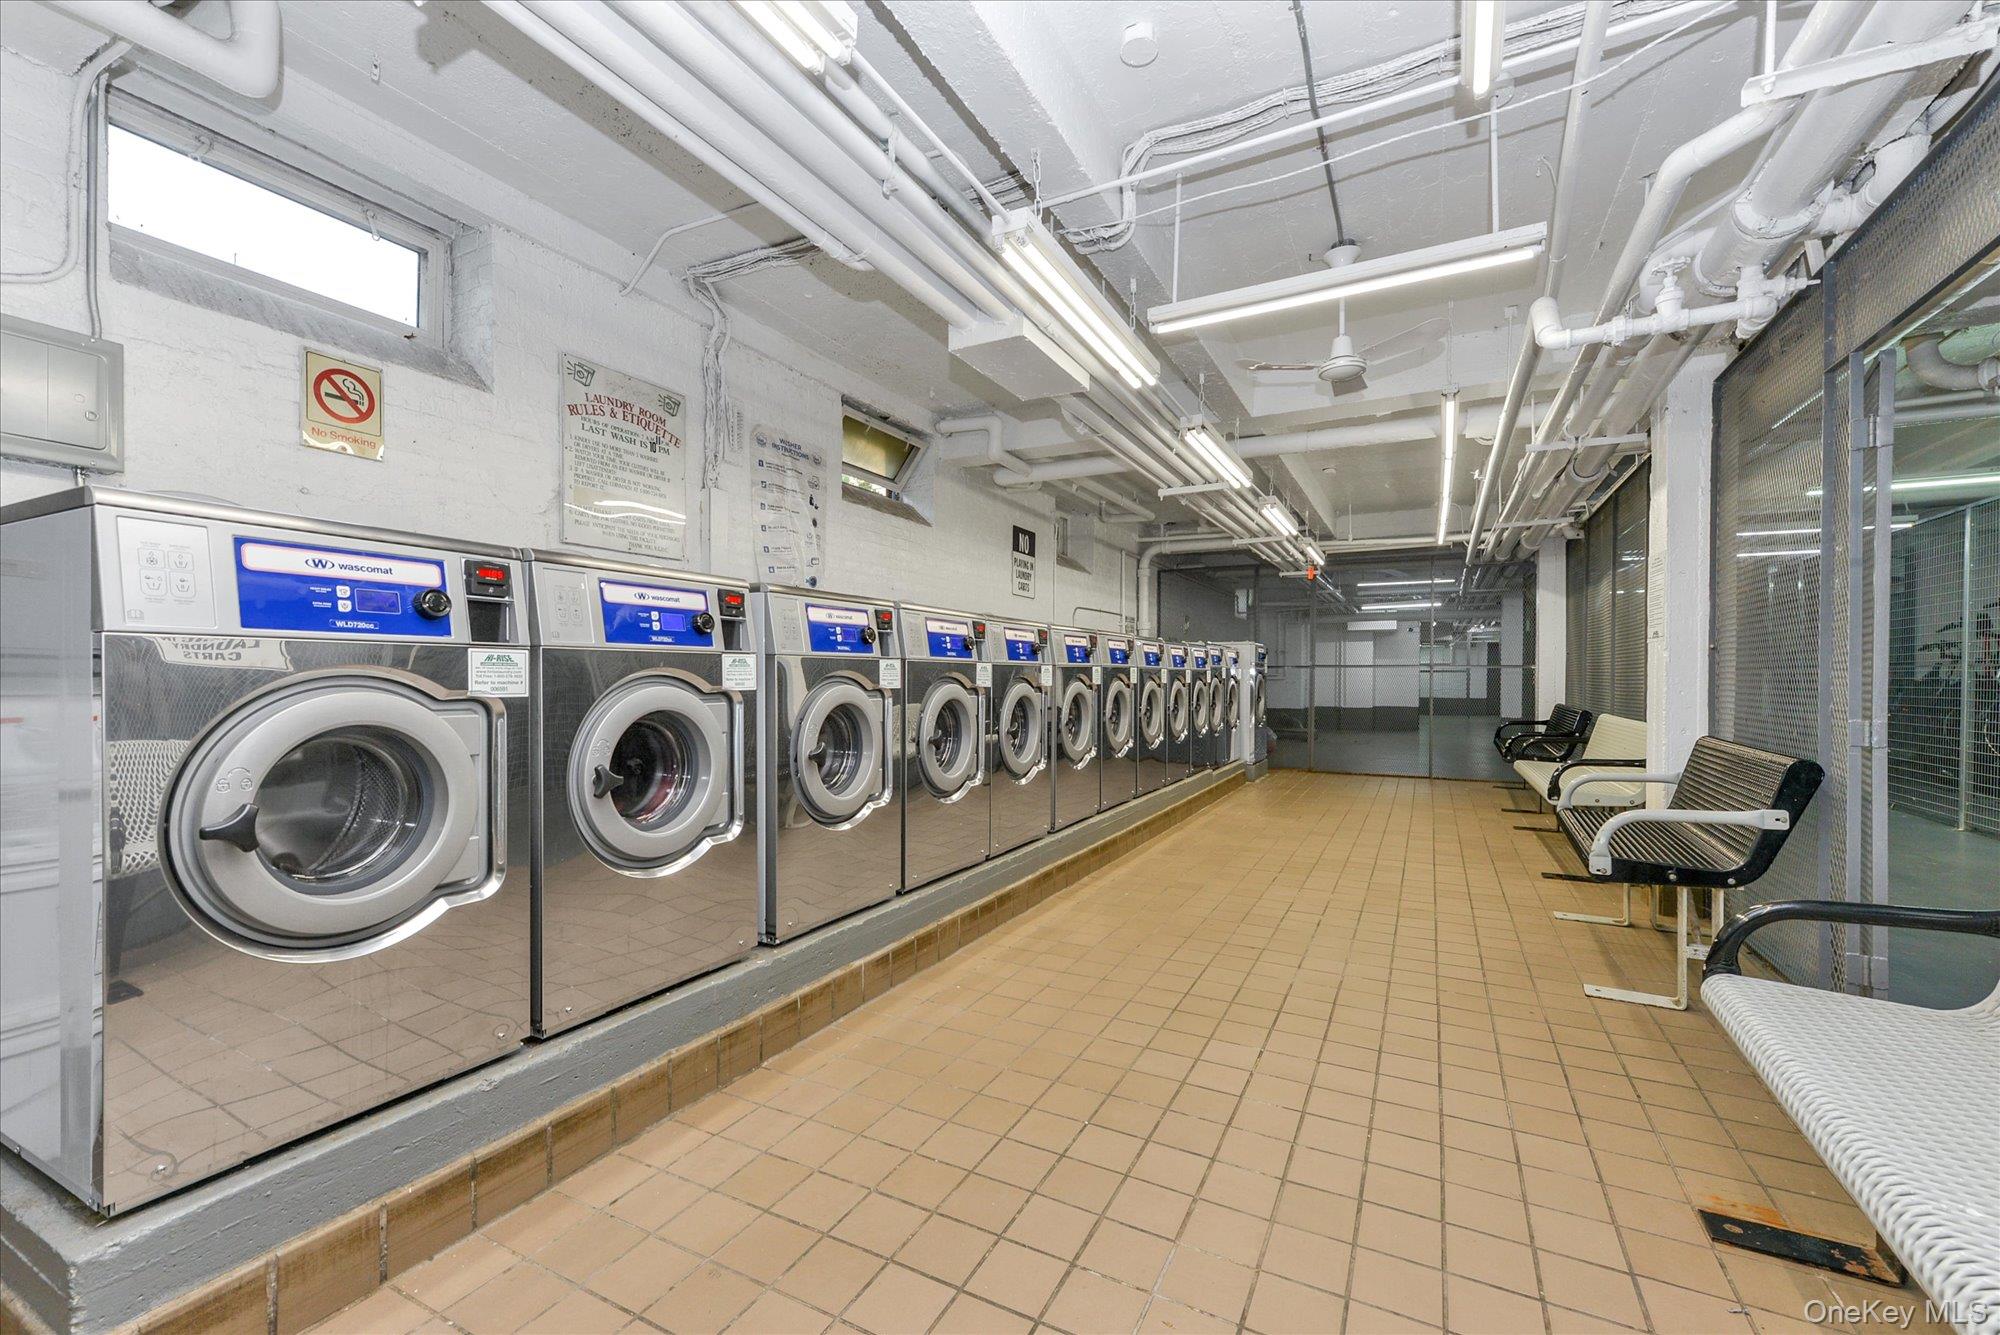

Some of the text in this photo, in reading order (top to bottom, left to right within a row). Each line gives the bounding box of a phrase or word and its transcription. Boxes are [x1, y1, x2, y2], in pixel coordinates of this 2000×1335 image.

[585, 392, 666, 427] LAUNDRY ROOM
[567, 404, 682, 448] RULES & ETIQUETTE
[580, 416, 600, 426] HOURS
[312, 427, 376, 449] No Smoking
[581, 423, 608, 436] LAST
[610, 430, 636, 446] WASH
[640, 440, 648, 450] IS
[658, 445, 670, 456] PM
[1019, 532, 1030, 554] NO
[338, 563, 393, 575] wascomat
[1014, 557, 1029, 569] PLAYING
[1016, 569, 1032, 581] LAUNDRY
[484, 654, 514, 662] HI-RISE
